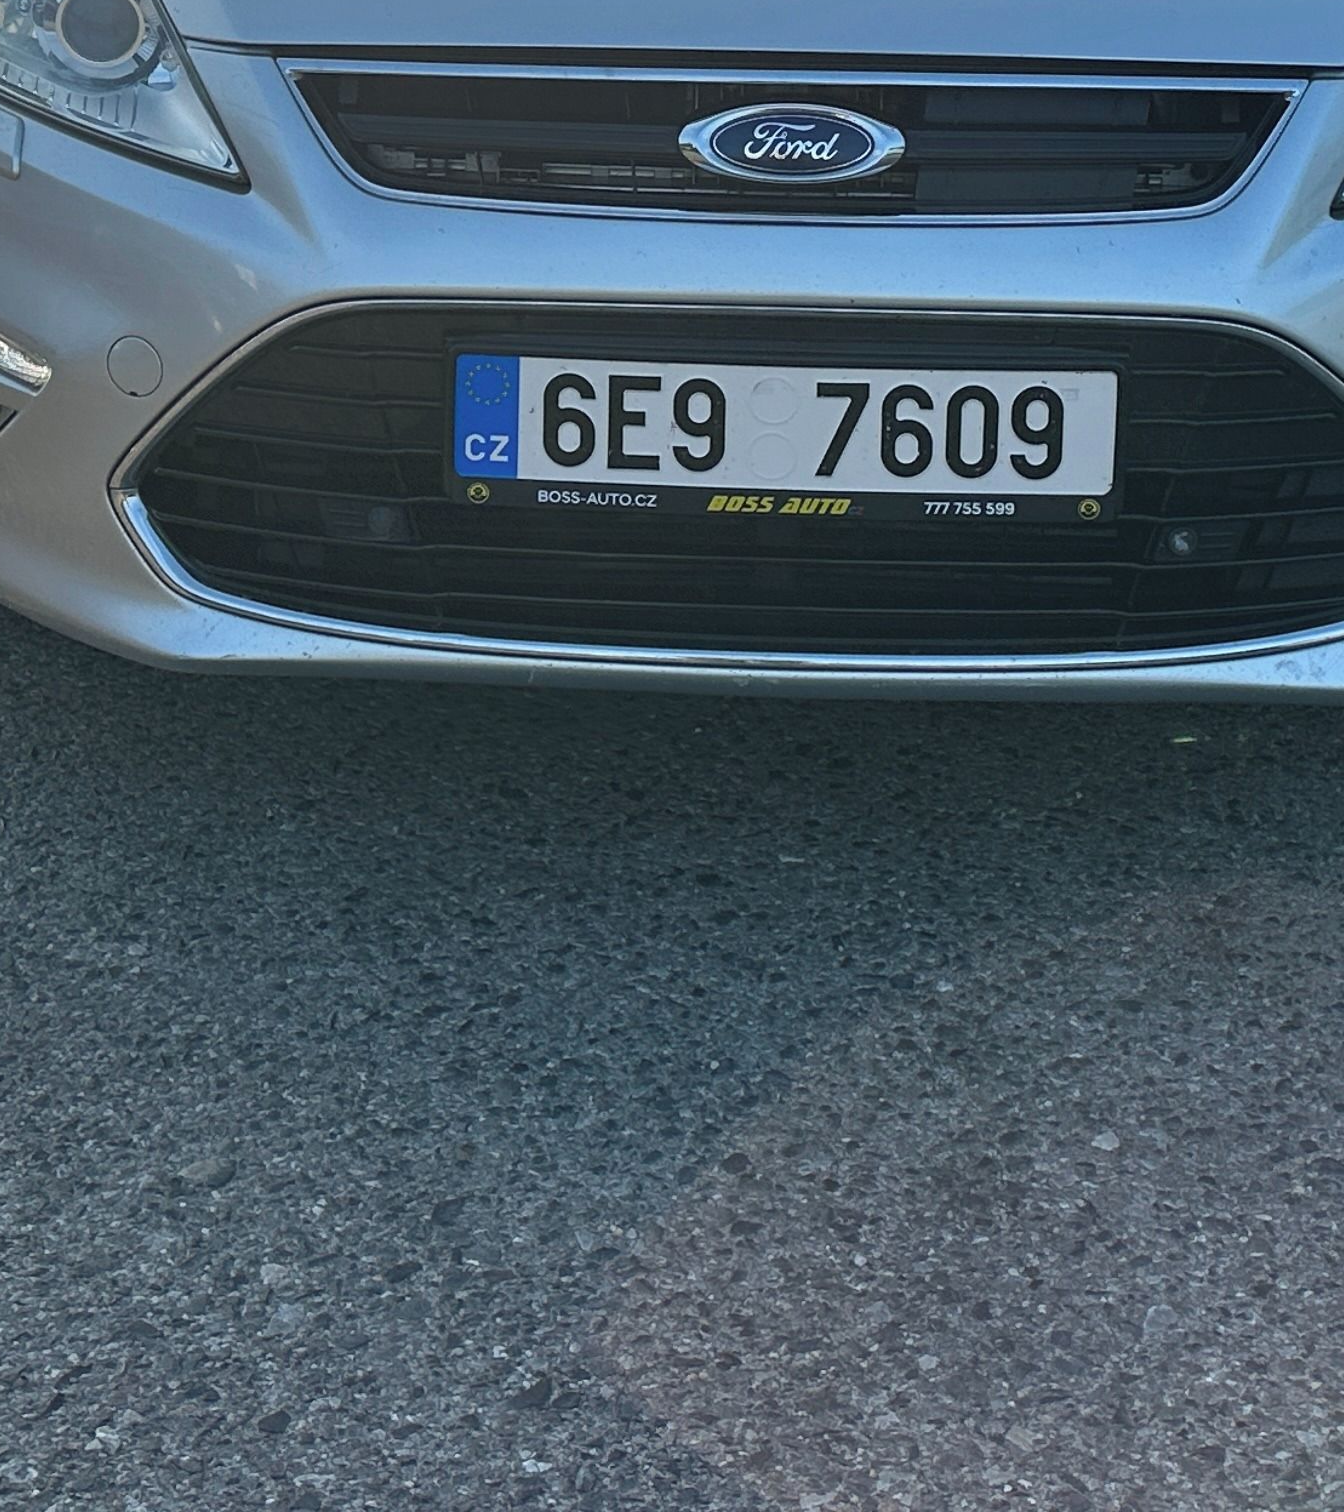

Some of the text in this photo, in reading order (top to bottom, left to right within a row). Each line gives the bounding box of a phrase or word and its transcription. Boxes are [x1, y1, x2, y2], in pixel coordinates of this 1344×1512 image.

[744, 121, 840, 161] Ford
[542, 372, 1065, 480] 6E9 7609
[464, 434, 509, 463] CZ
[537, 490, 657, 509] BOSS-AUTO.CZ
[706, 495, 775, 513] BOSS
[778, 497, 852, 515] AUTO
[923, 500, 951, 516] 777
[954, 501, 982, 516] 755
[985, 502, 1016, 517] 599
